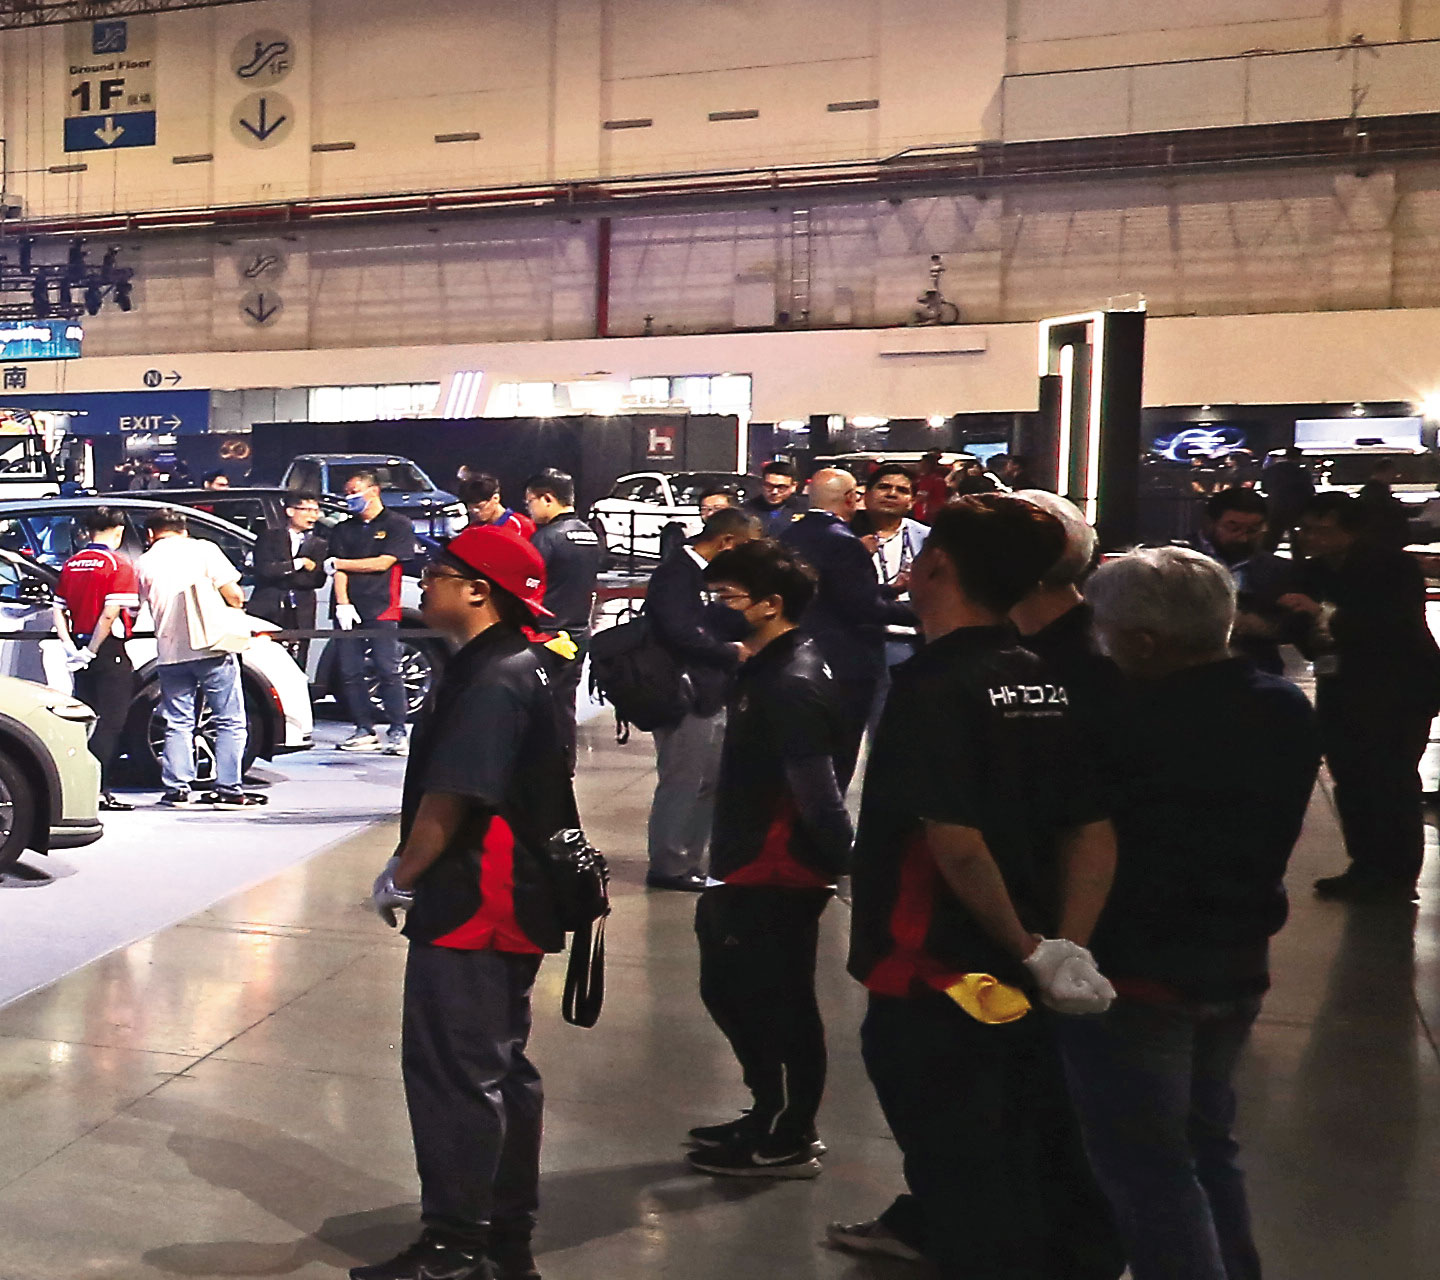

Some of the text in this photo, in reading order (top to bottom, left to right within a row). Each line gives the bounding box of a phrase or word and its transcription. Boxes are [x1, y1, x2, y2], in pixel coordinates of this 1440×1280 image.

[69, 60, 152, 75] Ground Floor
[269, 60, 289, 75] 1F
[71, 78, 126, 112] 1F
[3, 366, 28, 390] 南
[119, 415, 163, 431] EXIT
